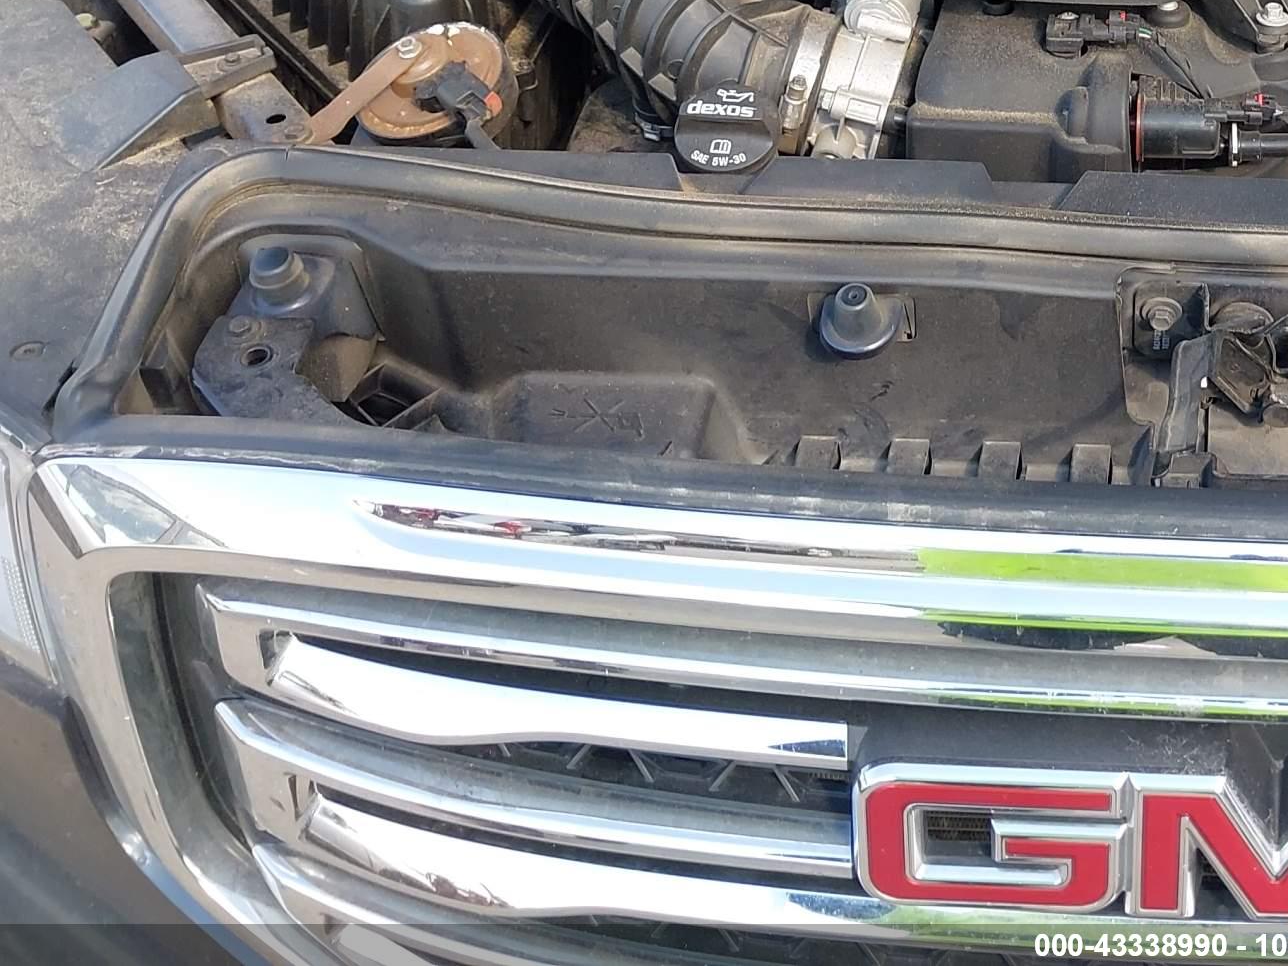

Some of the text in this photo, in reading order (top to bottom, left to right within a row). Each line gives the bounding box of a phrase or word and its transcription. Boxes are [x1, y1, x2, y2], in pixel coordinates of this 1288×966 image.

[687, 100, 757, 117] dexos
[691, 150, 746, 166] SAE 5W-30
